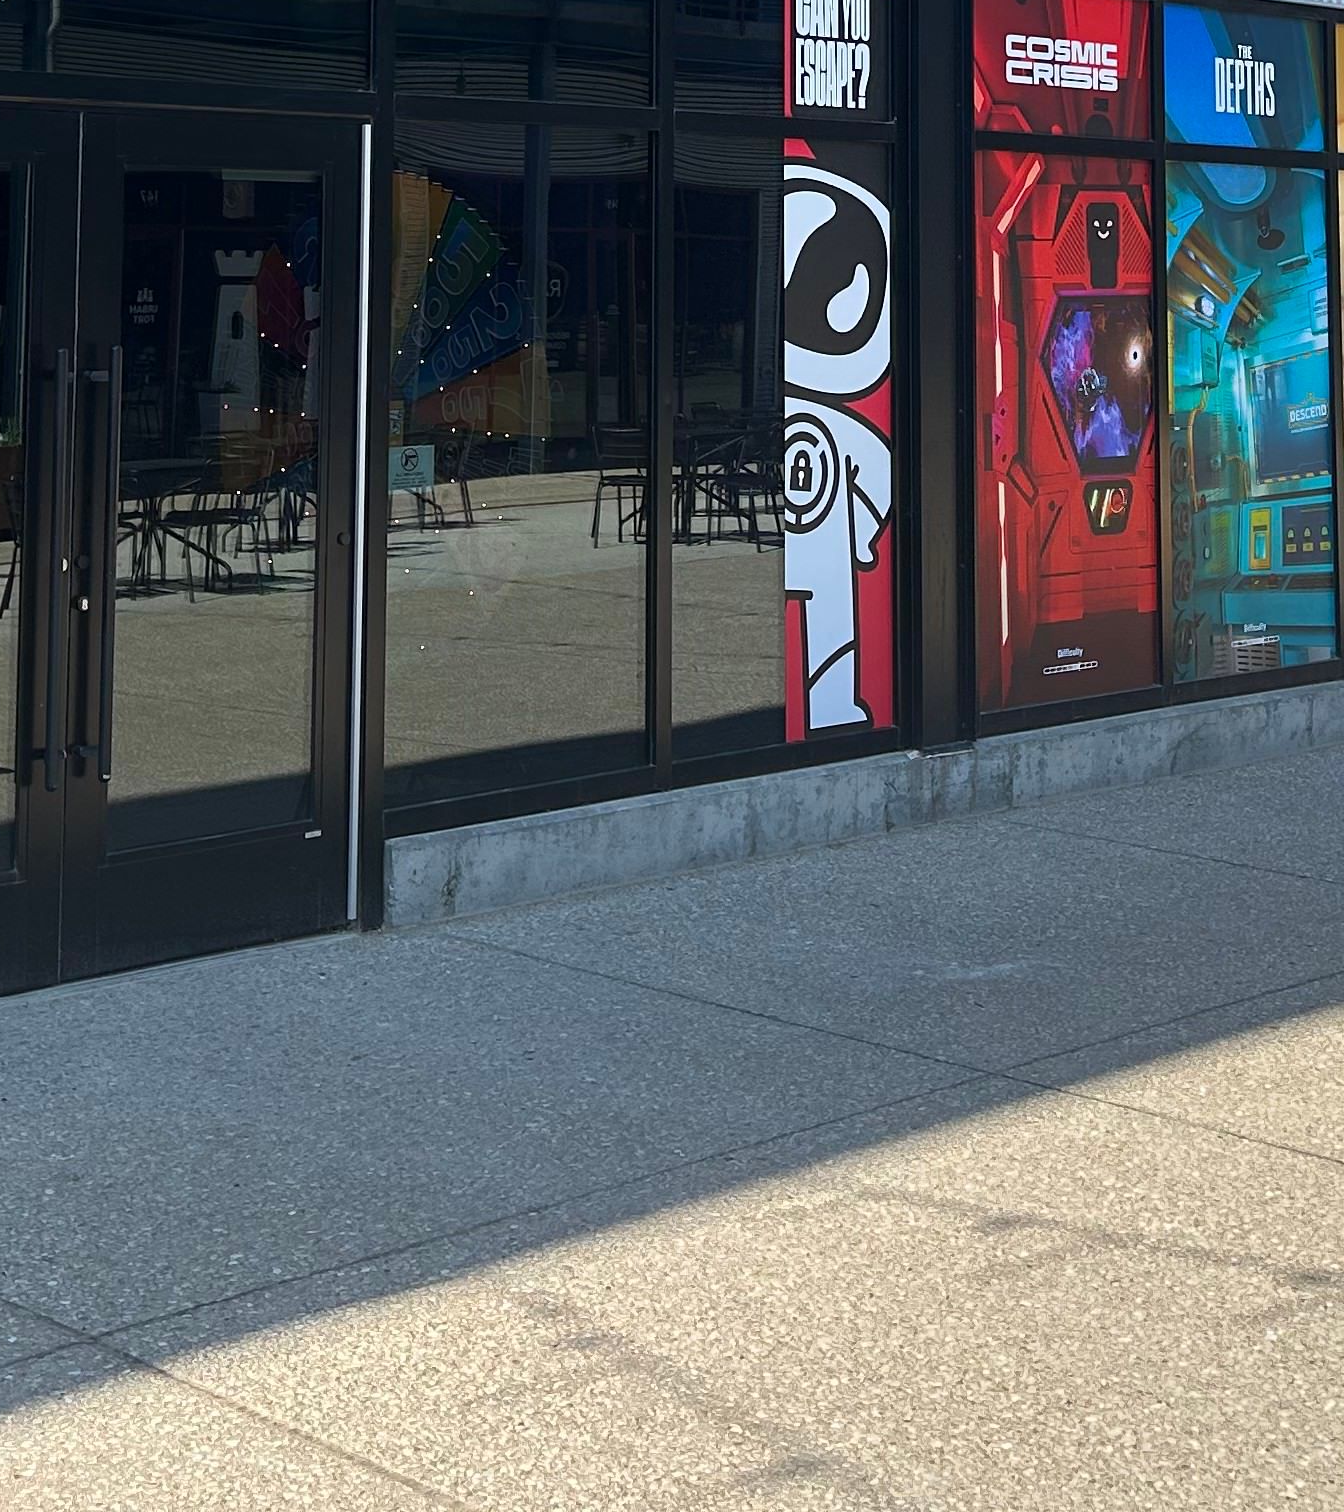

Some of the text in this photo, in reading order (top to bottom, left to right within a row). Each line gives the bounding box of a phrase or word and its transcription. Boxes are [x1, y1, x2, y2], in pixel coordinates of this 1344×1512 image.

[1006, 34, 1118, 67] COSMIC
[1237, 44, 1253, 60] THE
[795, 38, 871, 109] ESCAPE?
[1006, 60, 1118, 92] CRISIS
[1214, 56, 1275, 117] DEPTHS
[1289, 405, 1327, 422] DESCEND
